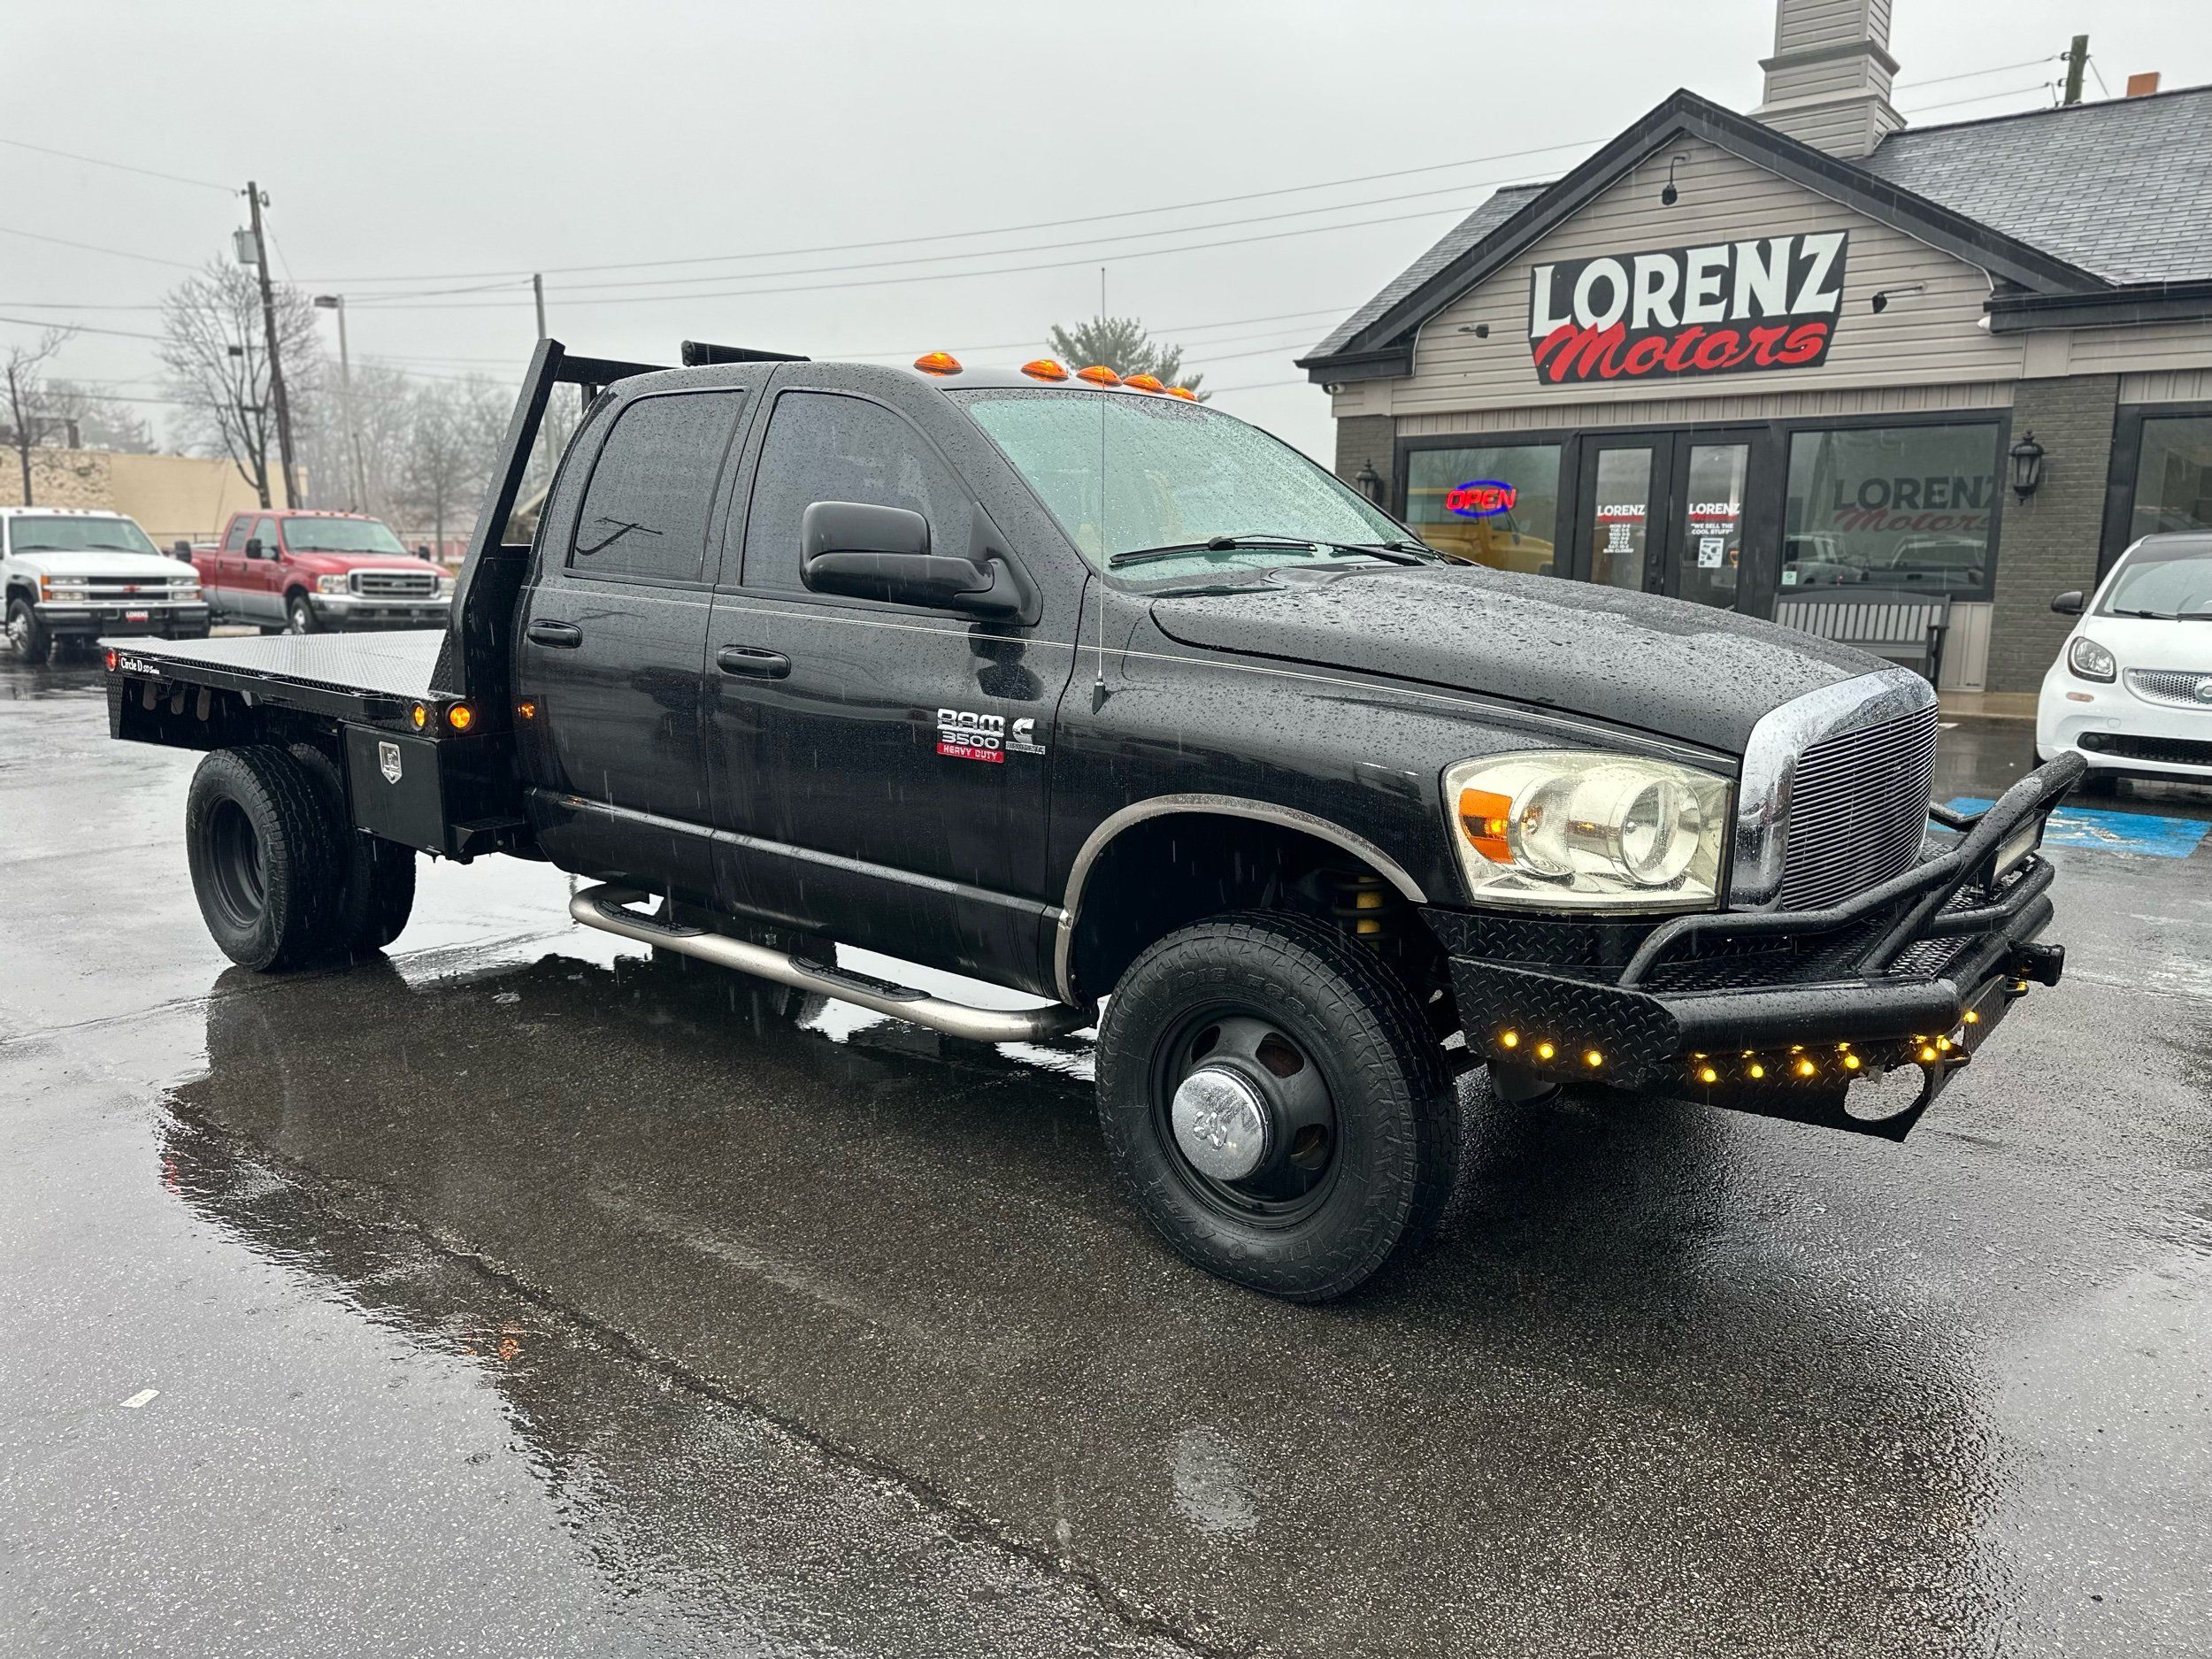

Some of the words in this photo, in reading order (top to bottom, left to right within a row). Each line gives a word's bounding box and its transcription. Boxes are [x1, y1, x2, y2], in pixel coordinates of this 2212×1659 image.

[1531, 233, 1846, 338] LORENZ
[1535, 321, 1828, 382] Motors
[1446, 488, 1517, 511] OPEN
[1597, 504, 1646, 516] LORENZ
[1688, 503, 1740, 516] LORENZ
[120, 657, 137, 672] Circle
[137, 659, 143, 672] D
[937, 708, 1006, 733] RAM
[941, 731, 1000, 749] 3500
[943, 744, 972, 757] HEAVY
[975, 749, 998, 761] DUTY
